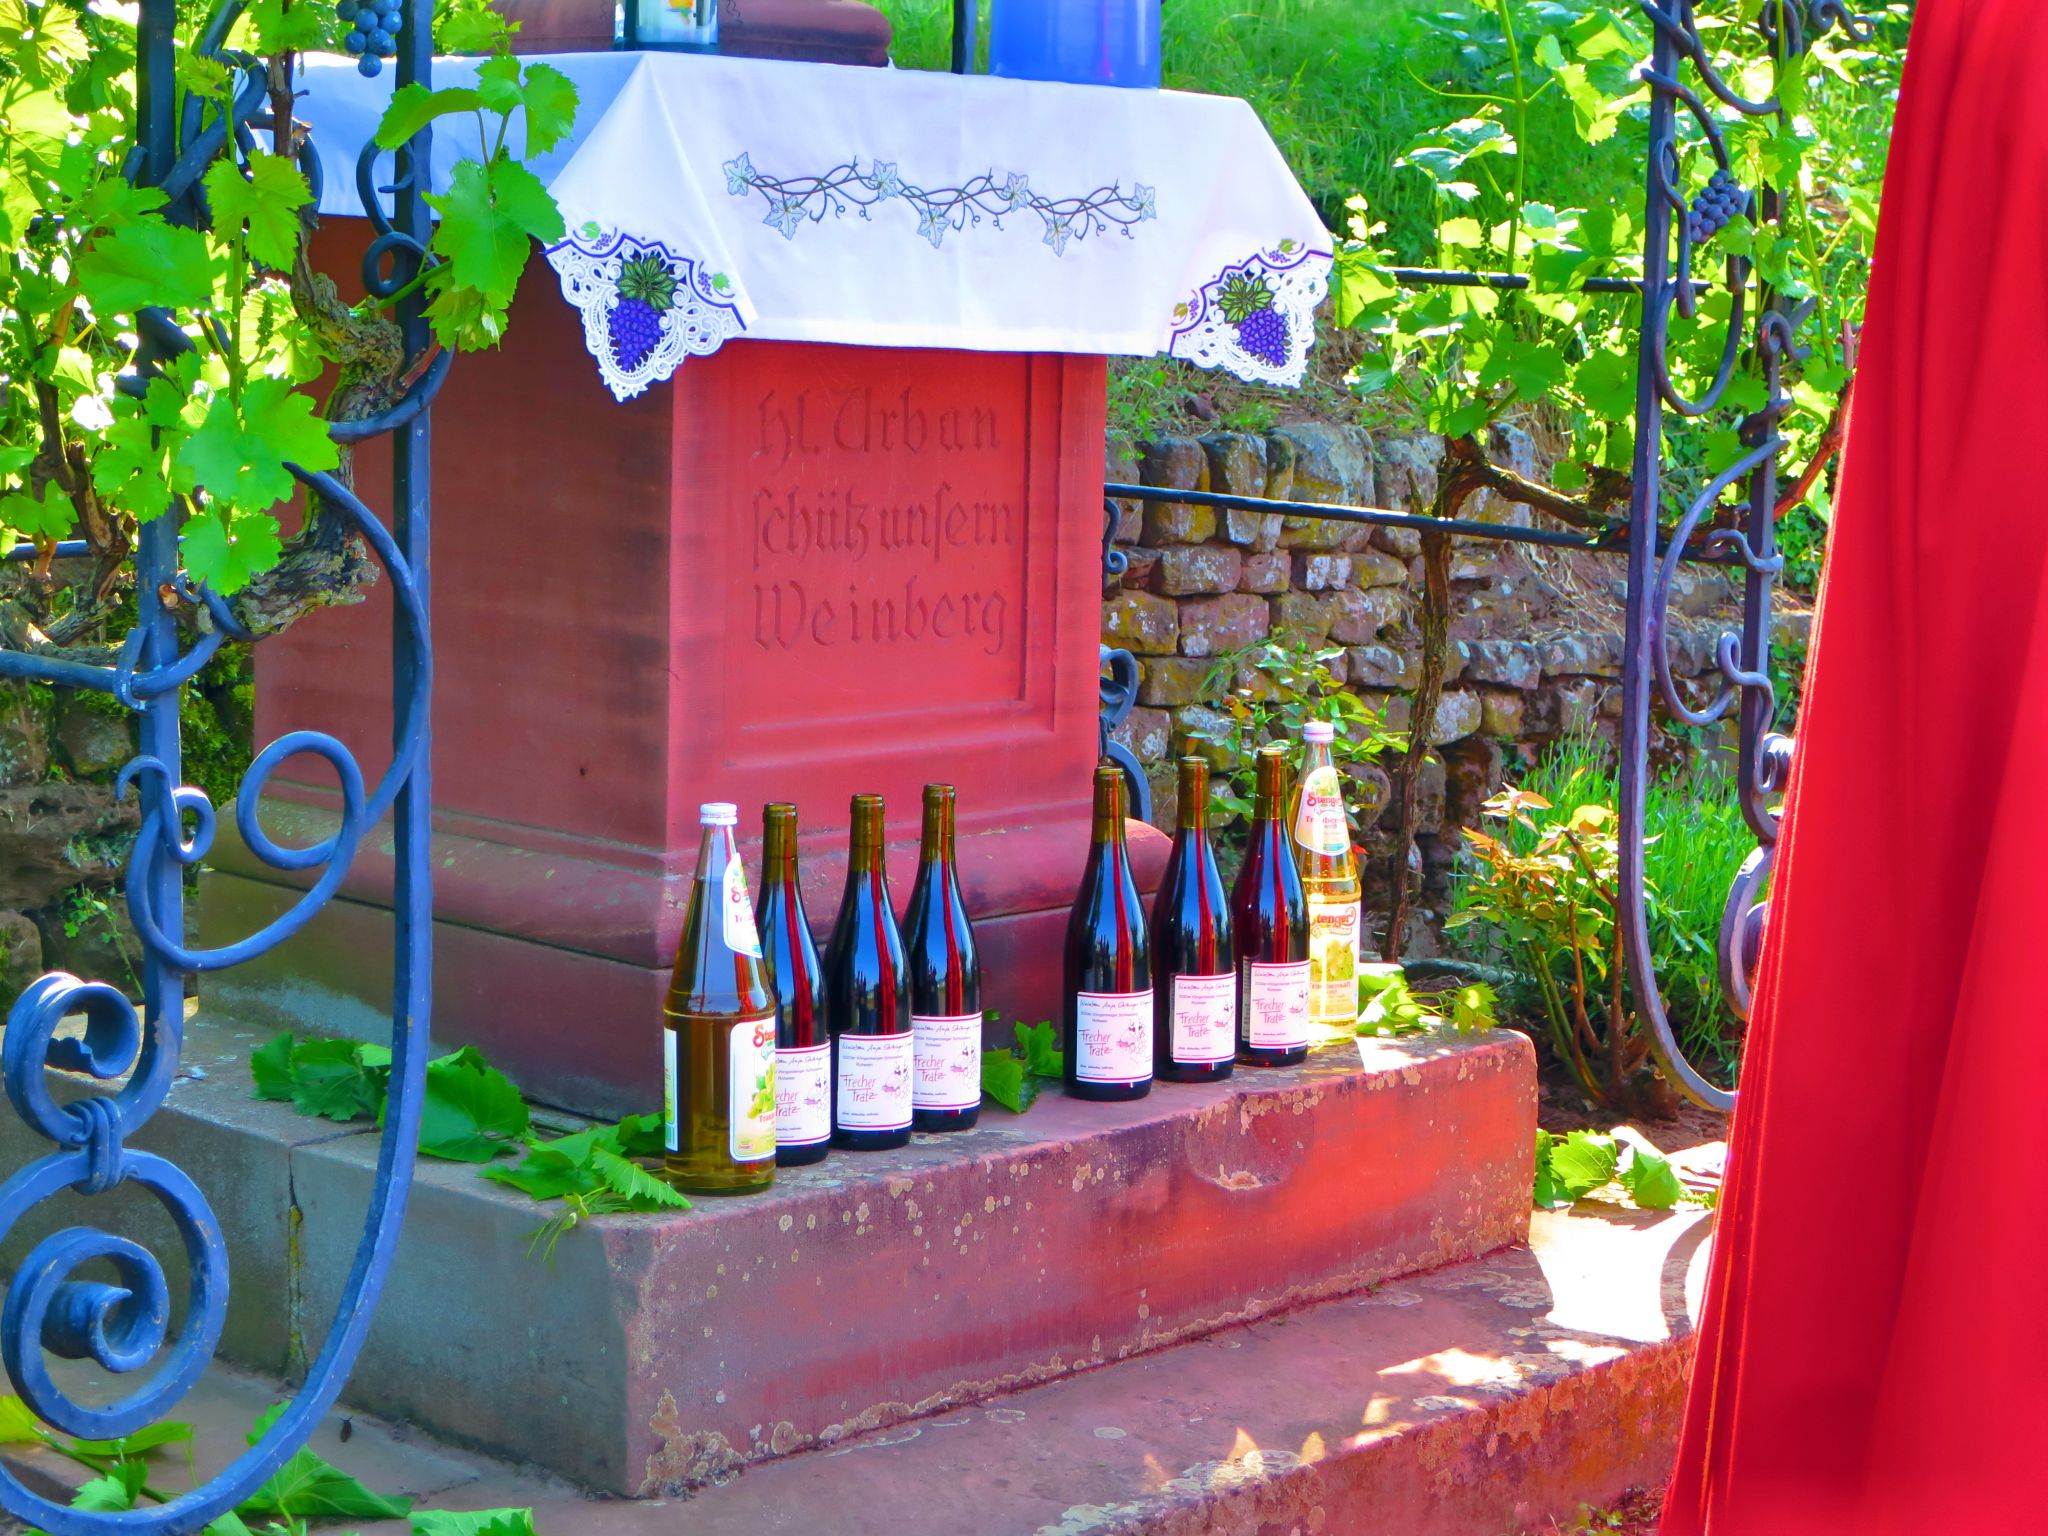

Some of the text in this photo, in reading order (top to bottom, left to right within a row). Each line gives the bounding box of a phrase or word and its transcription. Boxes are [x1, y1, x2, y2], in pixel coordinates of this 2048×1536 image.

[833, 386, 1002, 455] Urban
[753, 574, 1009, 656] Weinberg
[1311, 907, 1356, 927] tenger
[775, 1087, 801, 1102] echer
